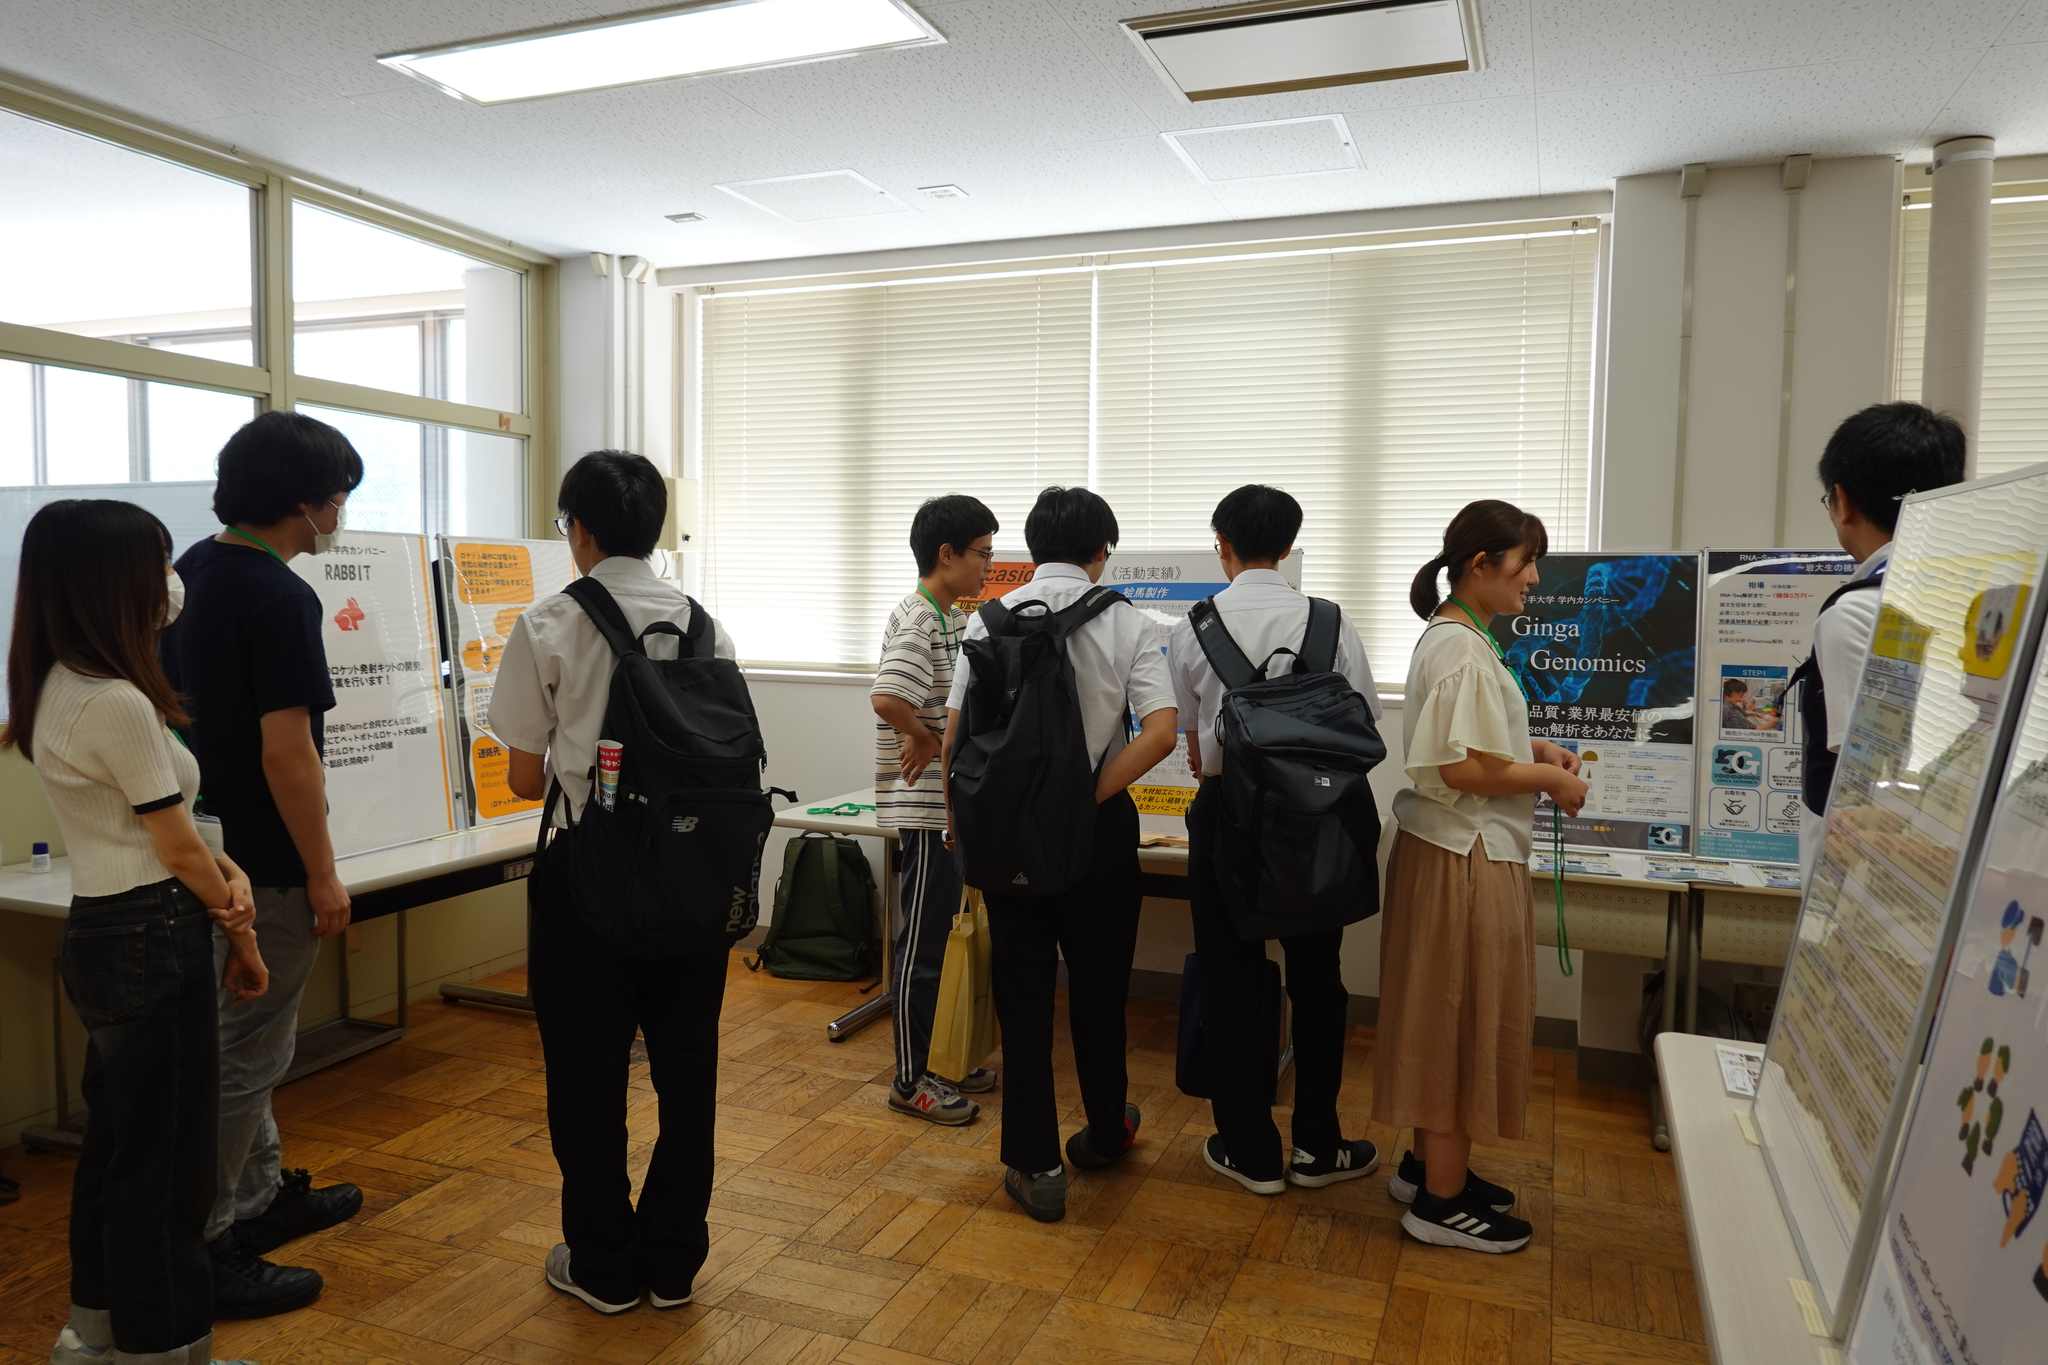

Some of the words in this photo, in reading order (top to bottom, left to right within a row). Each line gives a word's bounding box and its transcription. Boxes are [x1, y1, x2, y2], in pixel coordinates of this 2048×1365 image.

[325, 563, 371, 581] RABBIT
[1111, 565, 1182, 580] 《活動実績》
[1122, 587, 1169, 599] 絵馬製作
[1748, 582, 1765, 590] 相場
[1511, 615, 1580, 642] Ginga
[1530, 649, 1646, 673] Genomics
[1742, 669, 1767, 677] STEP1
[1529, 705, 1662, 723] 品質・業界最安値の
[478, 746, 501, 758] 連絡先
[725, 886, 746, 932] new
[914, 1092, 935, 1111] N
[1335, 1149, 1351, 1168] N
